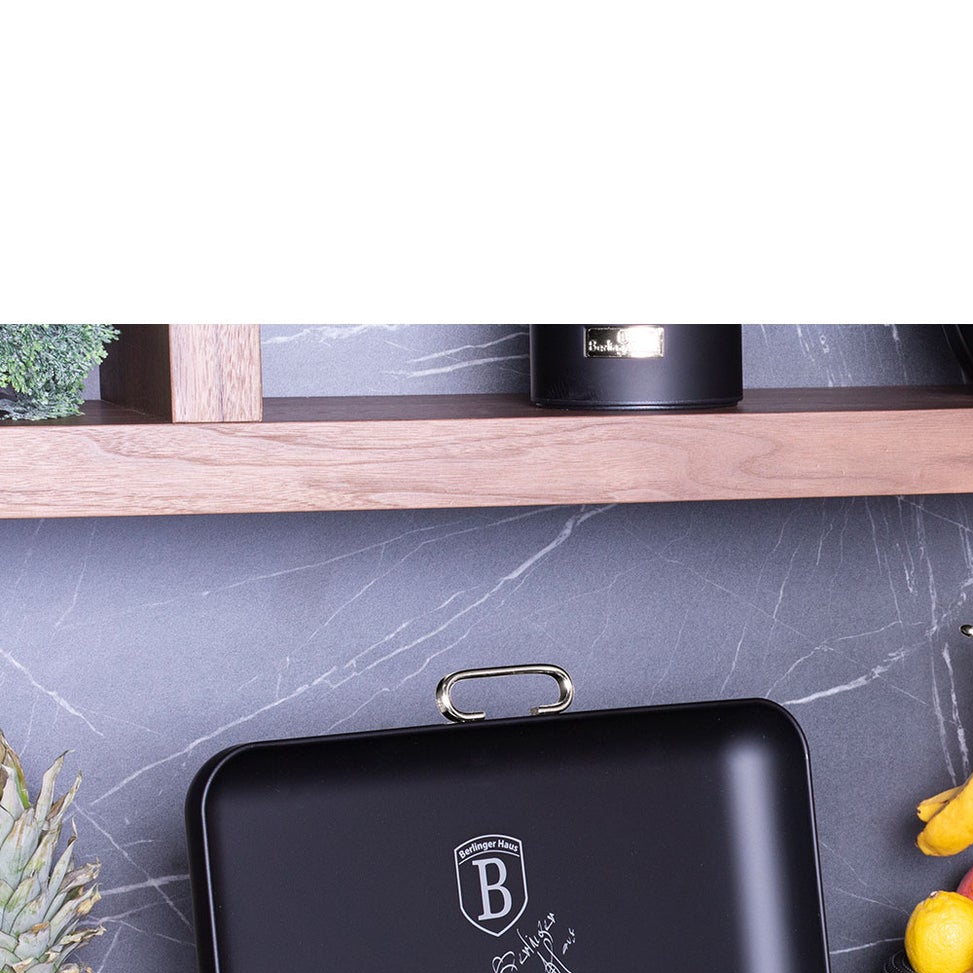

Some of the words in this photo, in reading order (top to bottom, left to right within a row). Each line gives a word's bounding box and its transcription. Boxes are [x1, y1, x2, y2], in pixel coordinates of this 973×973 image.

[459, 841, 497, 859] Berlinger
[498, 840, 518, 852] Haus
[472, 858, 512, 921] B
